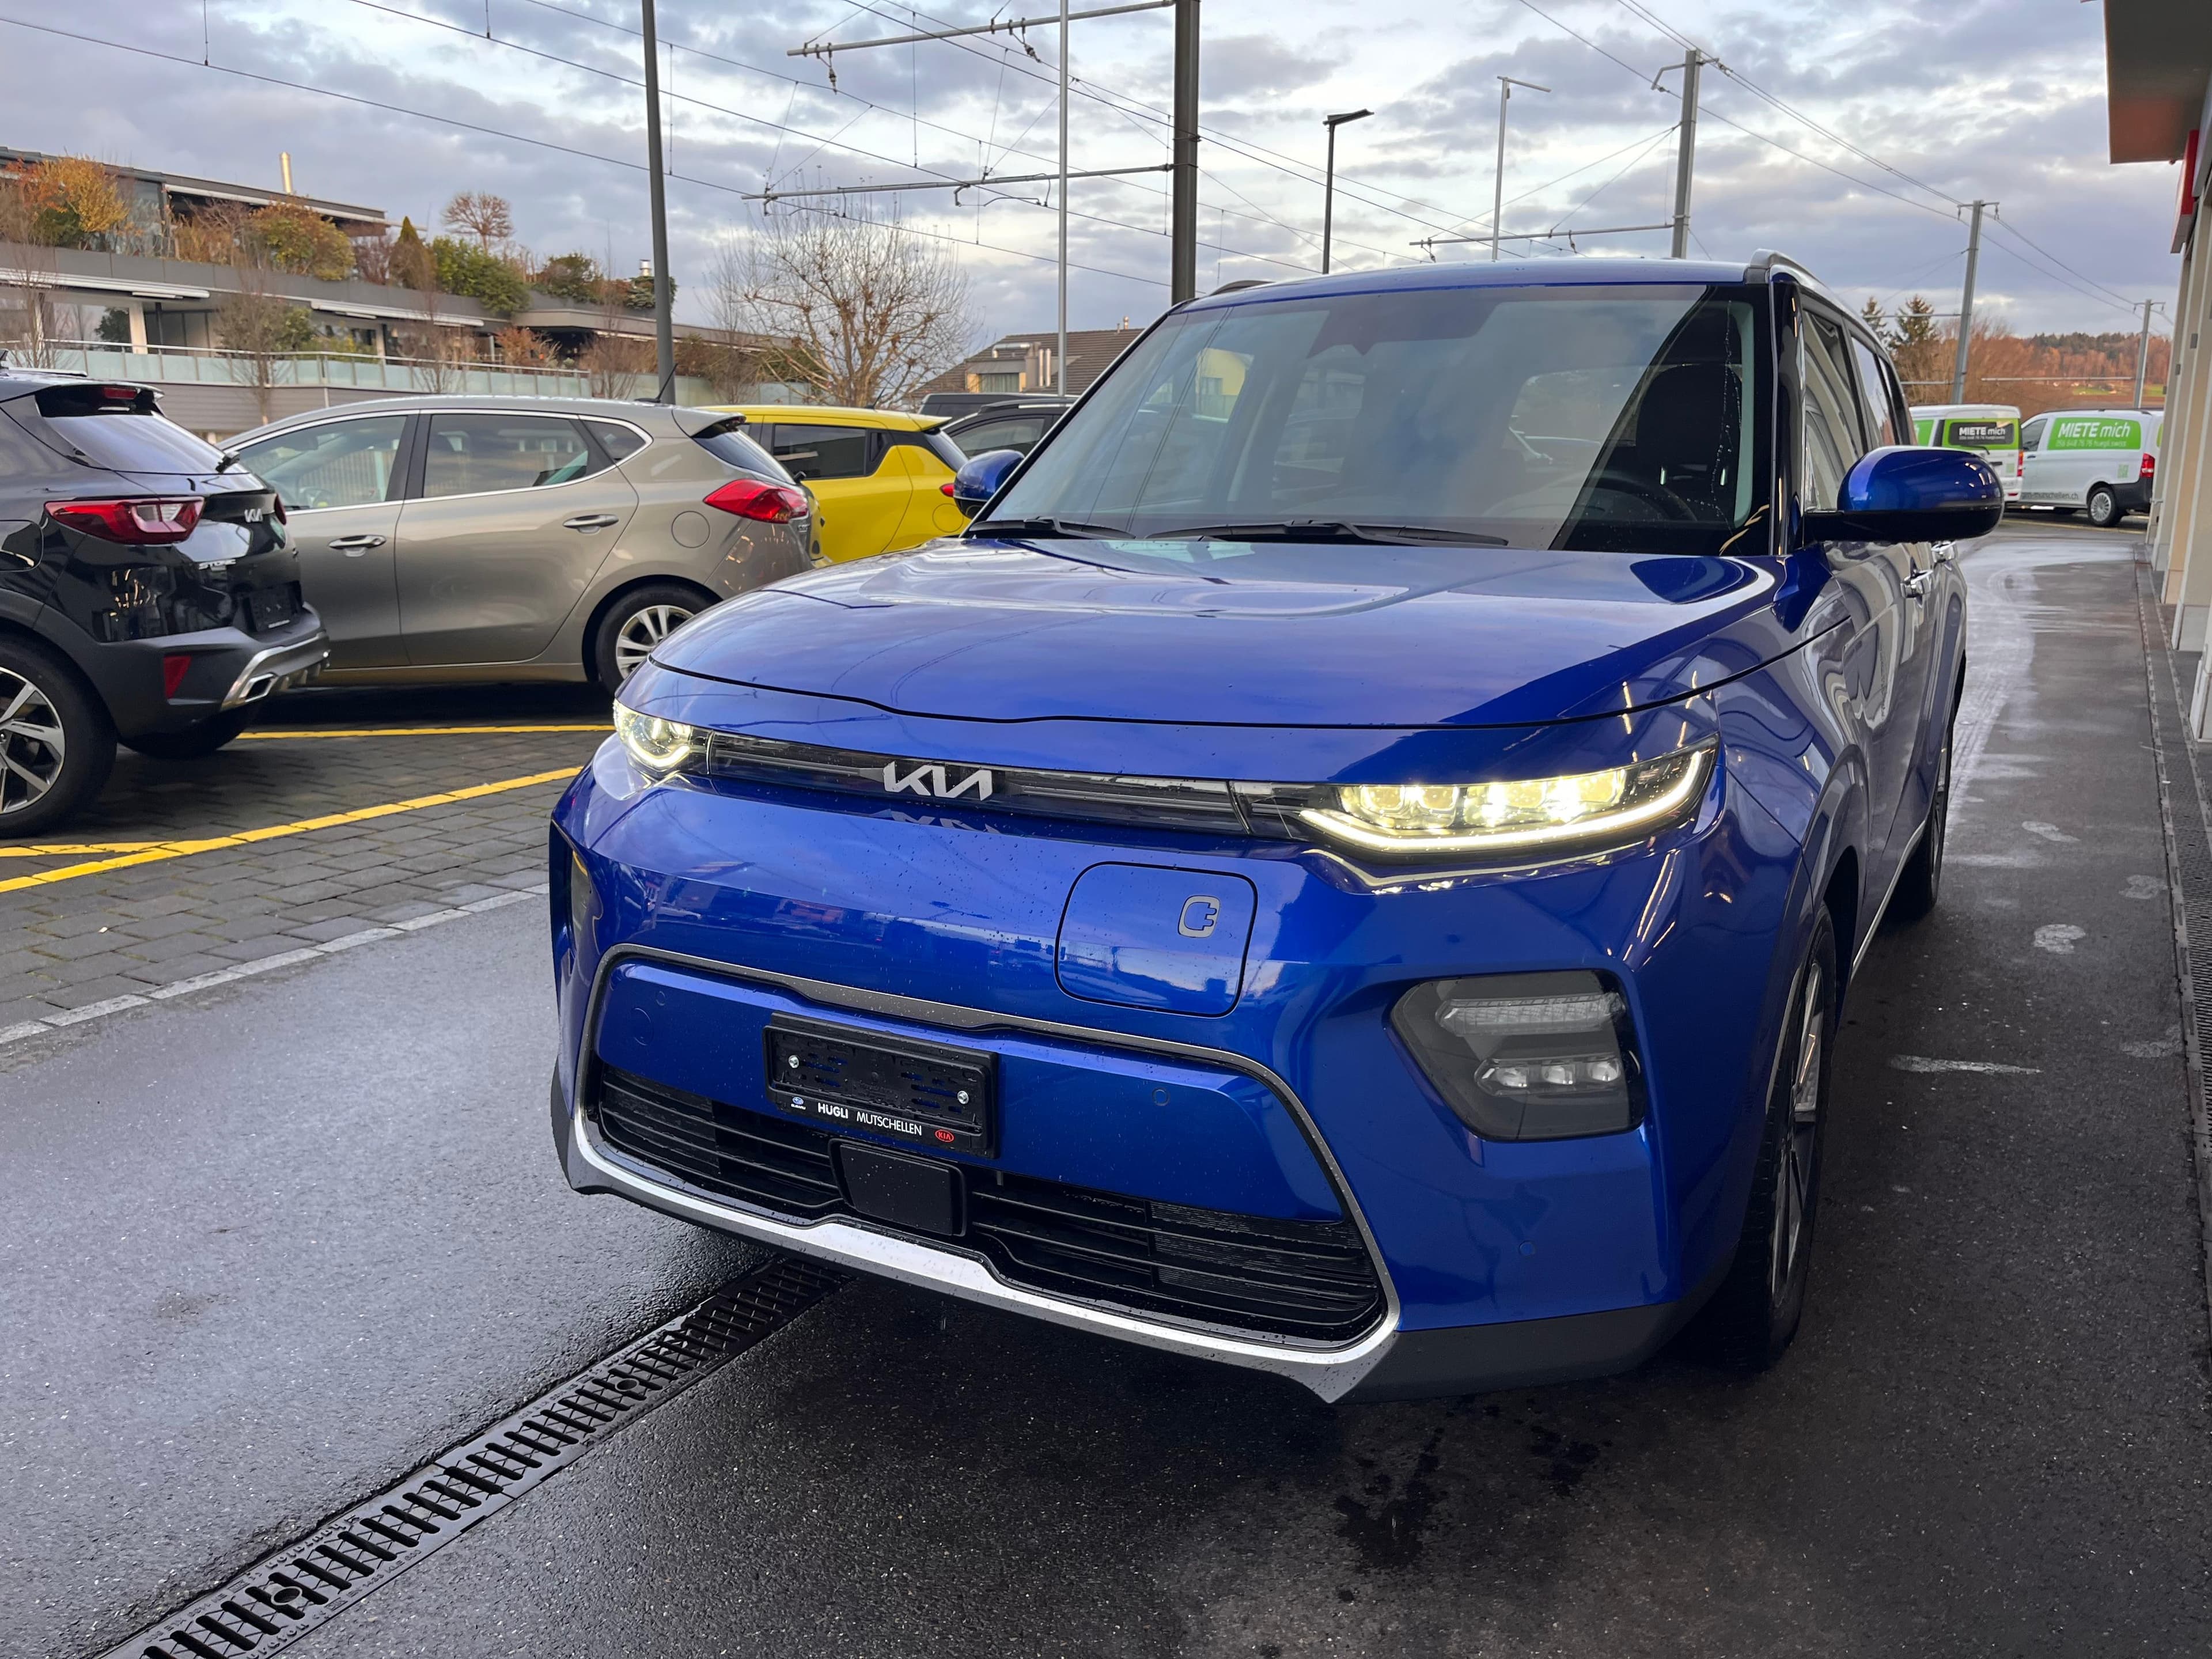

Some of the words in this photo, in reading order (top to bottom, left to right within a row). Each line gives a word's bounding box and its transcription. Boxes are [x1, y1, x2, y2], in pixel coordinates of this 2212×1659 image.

[1959, 427, 1986, 435] MIETE
[1987, 427, 2005, 435] mich
[2058, 422, 2100, 438] MIETE
[2100, 422, 2131, 438] mich
[883, 761, 993, 801] KIA
[857, 1111, 922, 1136] MUTSCHELLEN
[938, 1131, 952, 1141] KIA
